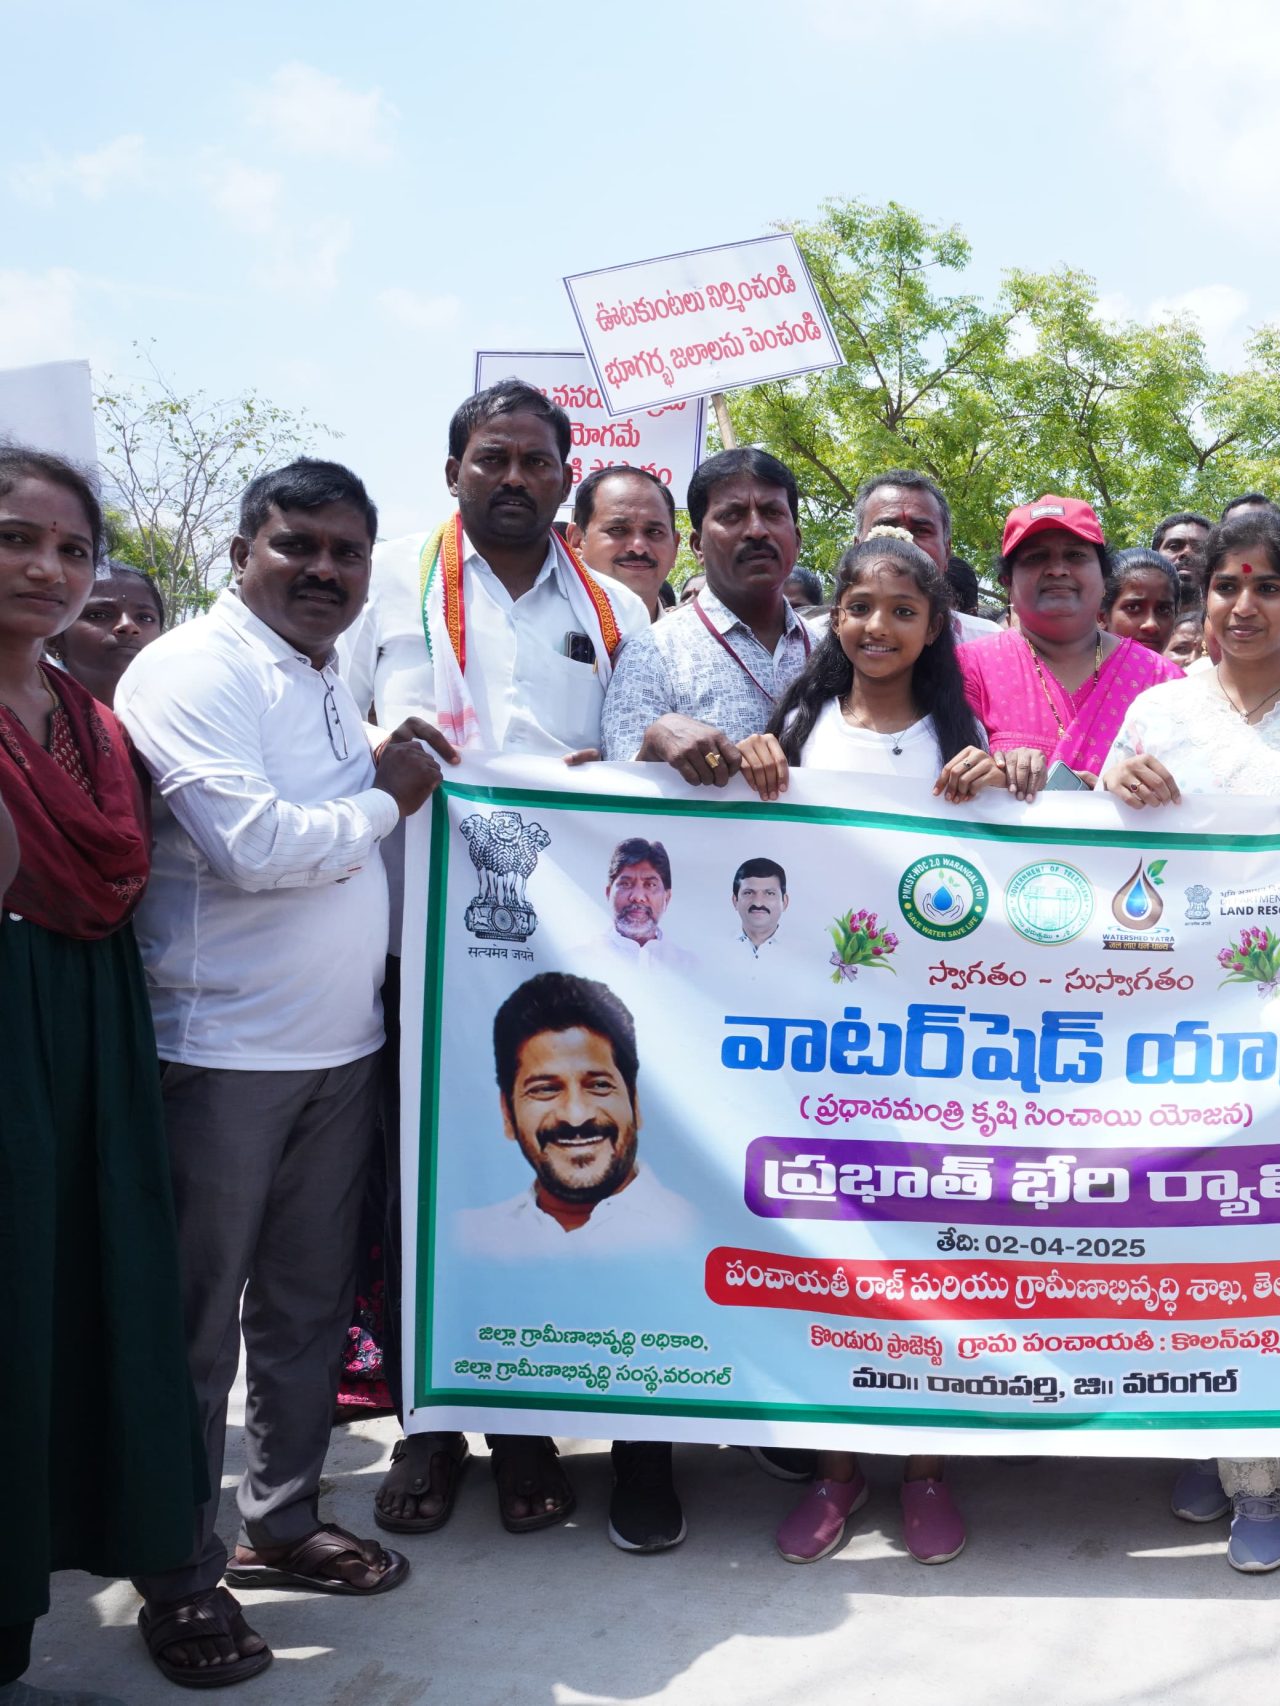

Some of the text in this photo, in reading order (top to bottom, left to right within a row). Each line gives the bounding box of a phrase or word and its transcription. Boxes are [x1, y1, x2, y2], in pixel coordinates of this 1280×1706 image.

[596, 264, 797, 332] ఊటకుంటలు నిర్మించండి
[670, 332, 745, 369] జలాలను
[743, 312, 823, 353] పెంచండి
[929, 858, 941, 867] 2.0
[942, 857, 977, 885] WARANGAL
[1009, 866, 1045, 898] GOVERNMENT
[907, 912, 979, 938] SAVE WATER SAVE LIFE
[1220, 906, 1254, 916] LAND
[468, 943, 534, 962] सत्यमेव जयते
[928, 960, 1027, 990] స్వాగతం
[1065, 967, 1194, 997] సుస్వాగతం
[971, 1102, 1018, 1138] కృషి
[1024, 1106, 1142, 1128] సించాయి
[1149, 1103, 1254, 1129] యోజన)
[763, 1154, 995, 1204] ప్రభాత్
[985, 1234, 1146, 1258] 02-04-2025
[725, 1259, 849, 1298] పంచాయతీ
[855, 1267, 907, 1301] రాజ్
[910, 1269, 1009, 1301] మరియు
[1015, 1268, 1181, 1317] గ్రామీణాభివృద్ధి
[478, 1326, 516, 1346] జిల్లా
[885, 1333, 943, 1367] ప్రాజెక్టు
[957, 1334, 1017, 1360] గ్రామ
[1022, 1328, 1155, 1352] పంచాయతీ
[454, 1359, 492, 1380] జిల్లా
[1123, 1368, 1239, 1395] వరంగల్
